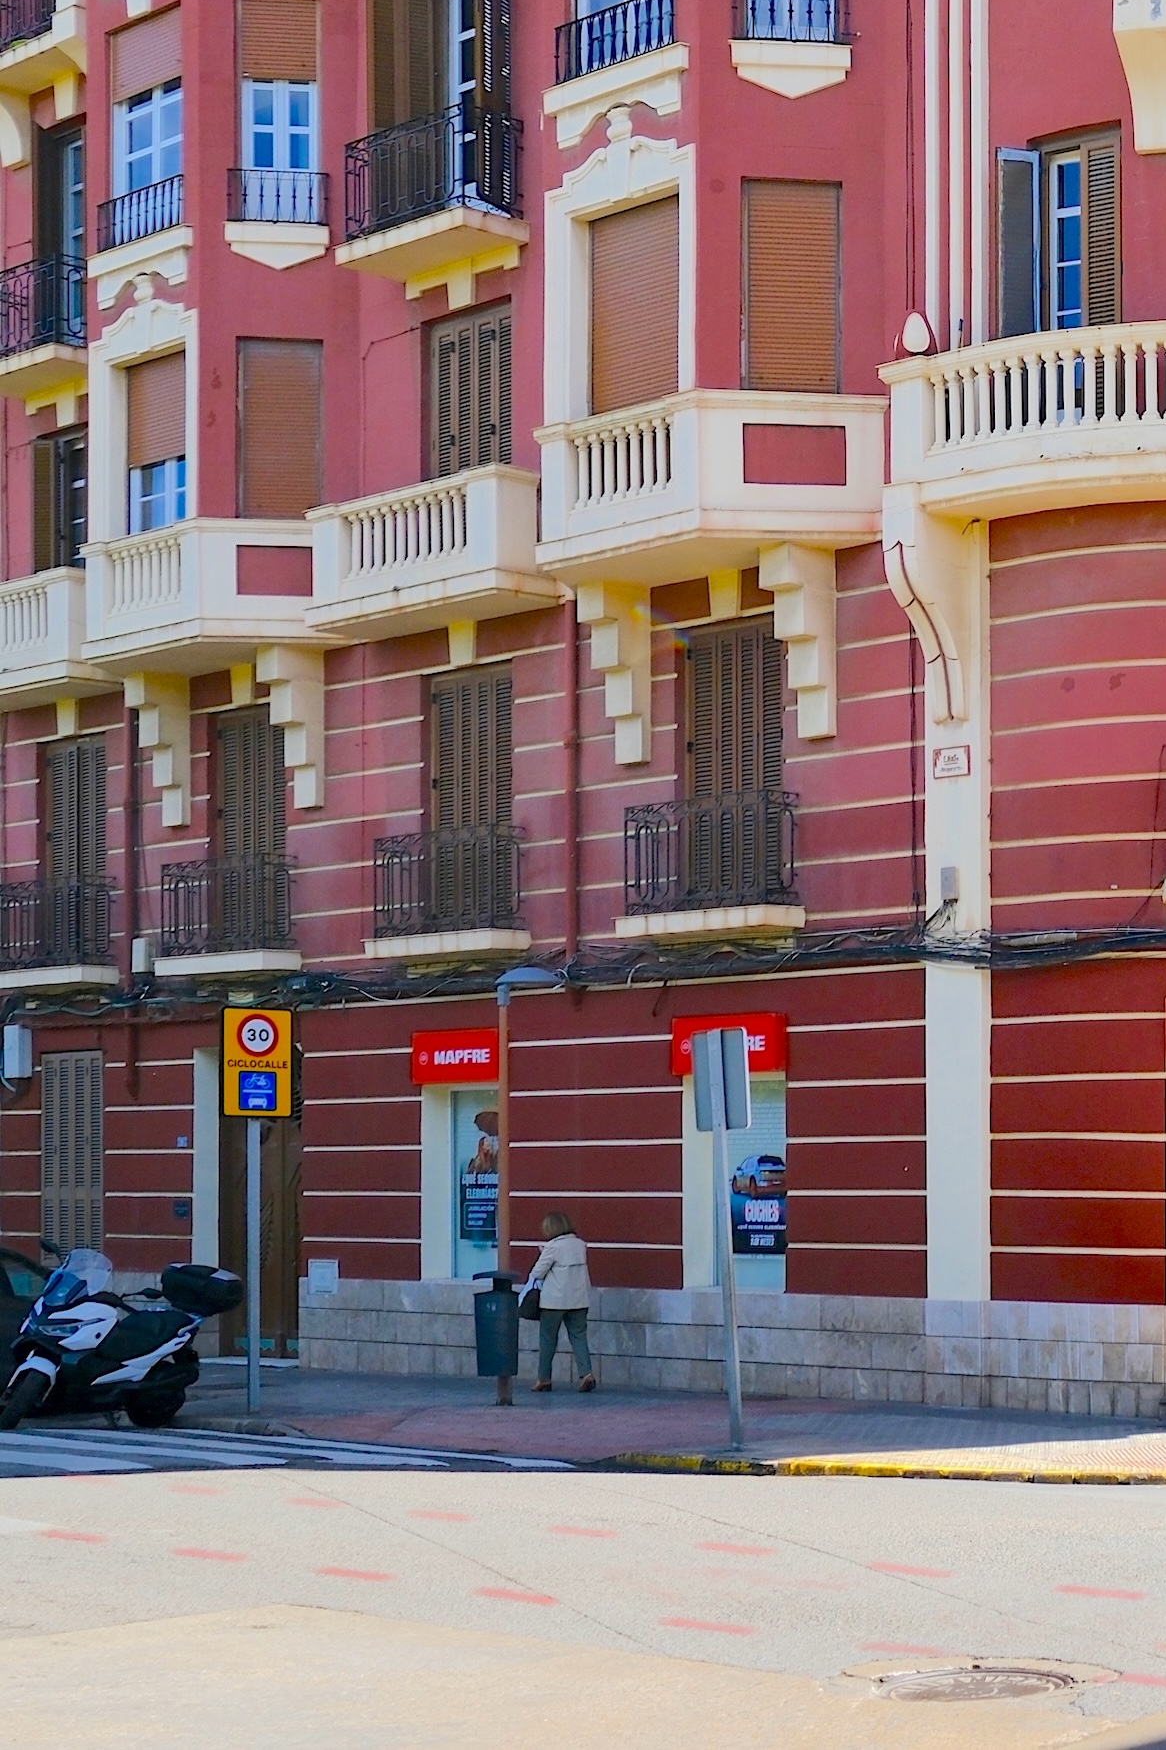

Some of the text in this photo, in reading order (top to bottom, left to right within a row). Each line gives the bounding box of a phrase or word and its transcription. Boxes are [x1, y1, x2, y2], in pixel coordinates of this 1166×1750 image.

[247, 1028, 269, 1042] 30
[227, 1059, 288, 1069] CICLOCALLE
[433, 1048, 490, 1065] MAPFRE
[744, 1199, 780, 1223] COCHES
